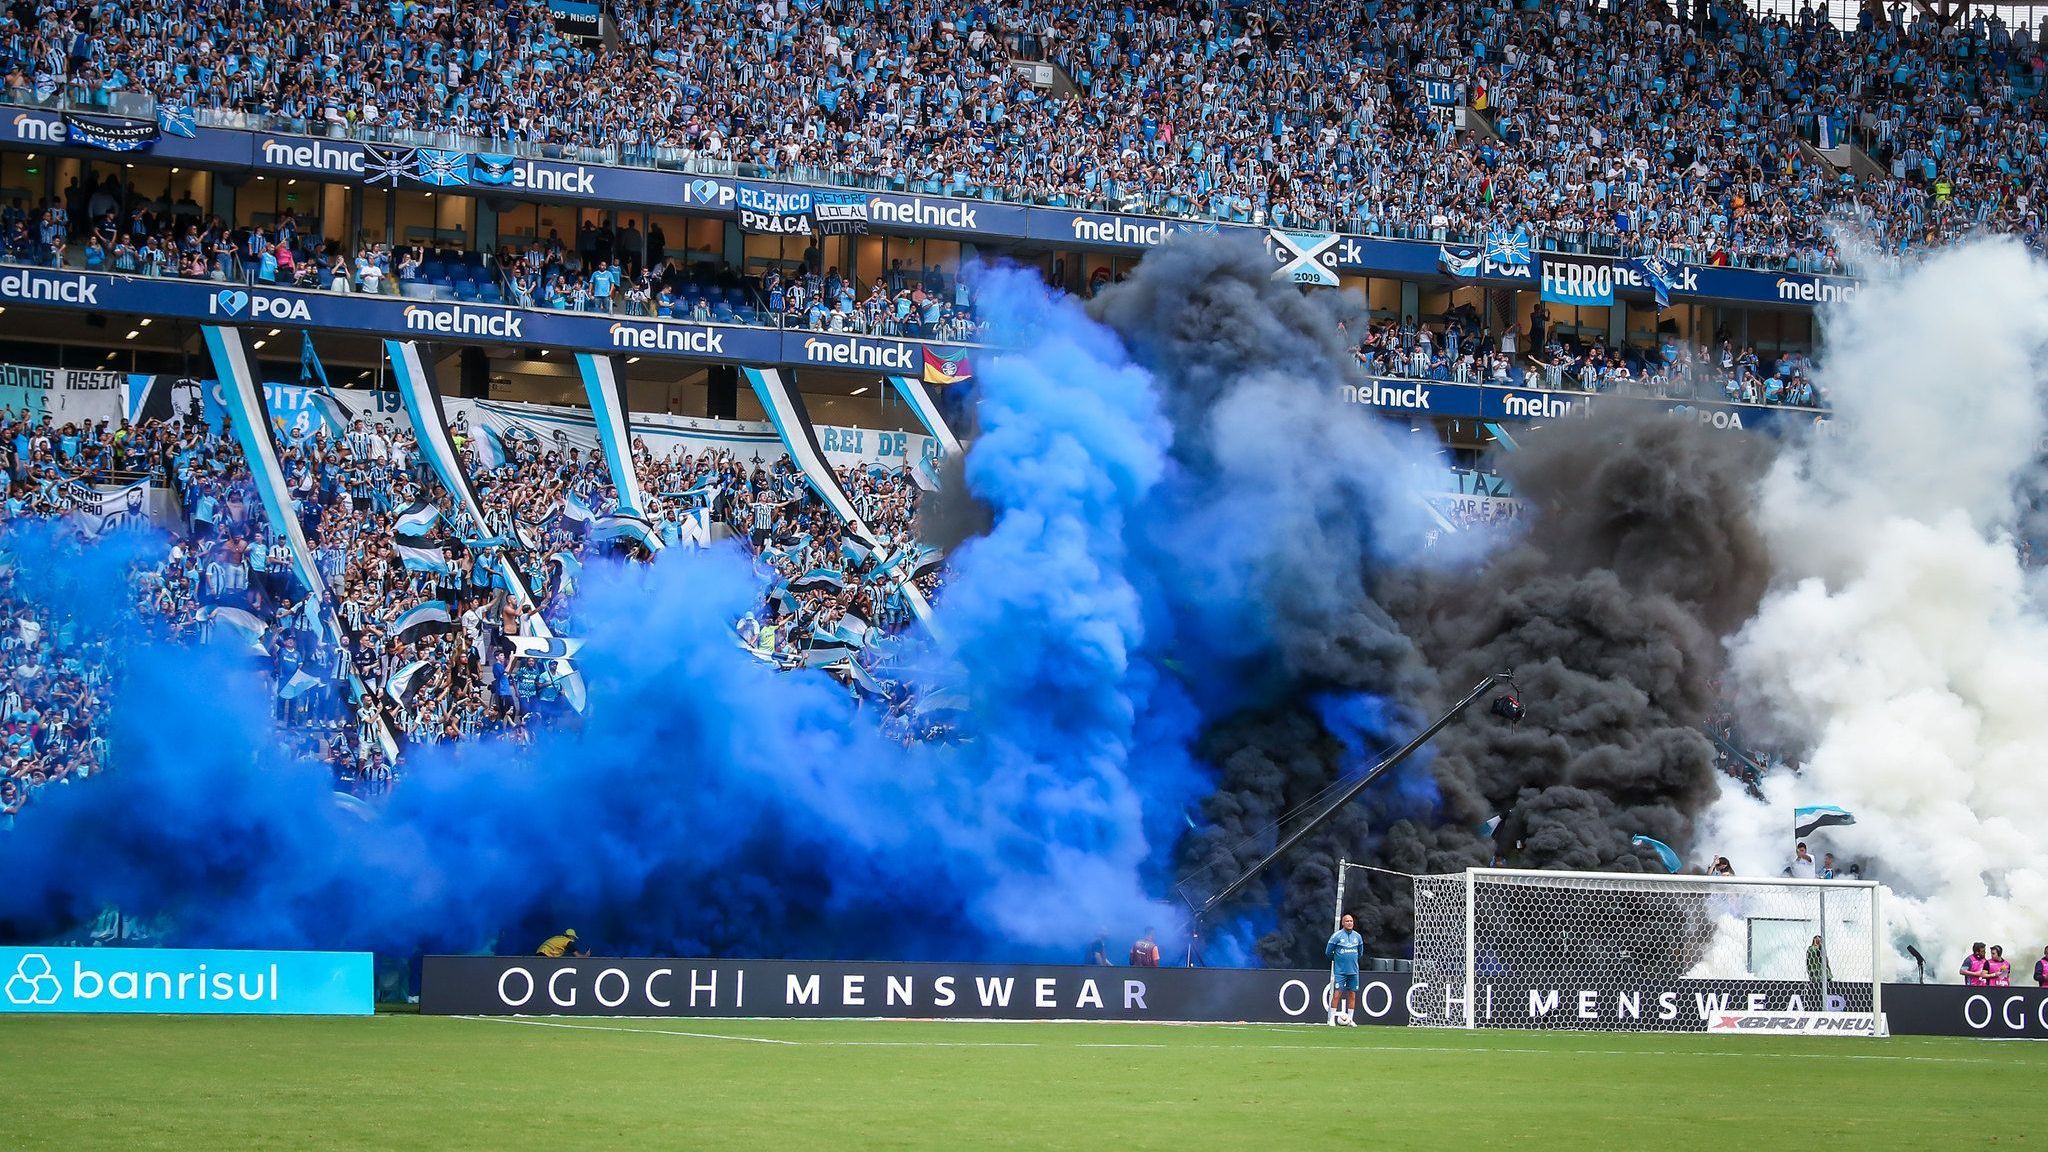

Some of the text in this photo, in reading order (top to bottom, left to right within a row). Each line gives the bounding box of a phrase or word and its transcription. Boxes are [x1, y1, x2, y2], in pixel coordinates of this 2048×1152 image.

[264, 141, 366, 172] melnic
[512, 162, 595, 194] elnick
[740, 187, 810, 211] ELENCO
[814, 192, 866, 204] SEMPRE
[818, 205, 867, 217] LOCAL
[741, 210, 811, 233] PRAÇA
[872, 198, 977, 229] melnick
[1075, 218, 1174, 246] melnick
[1275, 247, 1288, 262] C
[1322, 251, 1338, 267] Q
[1, 270, 98, 305] elnick
[1294, 272, 1320, 282] 2009
[1542, 261, 1611, 298] FERRO
[209, 294, 312, 321] I POA
[407, 306, 523, 338] melnick
[613, 324, 724, 354] melnick
[808, 338, 914, 368] melnick
[1341, 381, 1430, 410] melnick
[1700, 410, 1744, 431] POA
[823, 427, 863, 454] REI
[878, 432, 907, 457] DE
[73, 961, 278, 1000] banrisul
[497, 967, 1147, 1010] OGOCHI MENSWEAR
